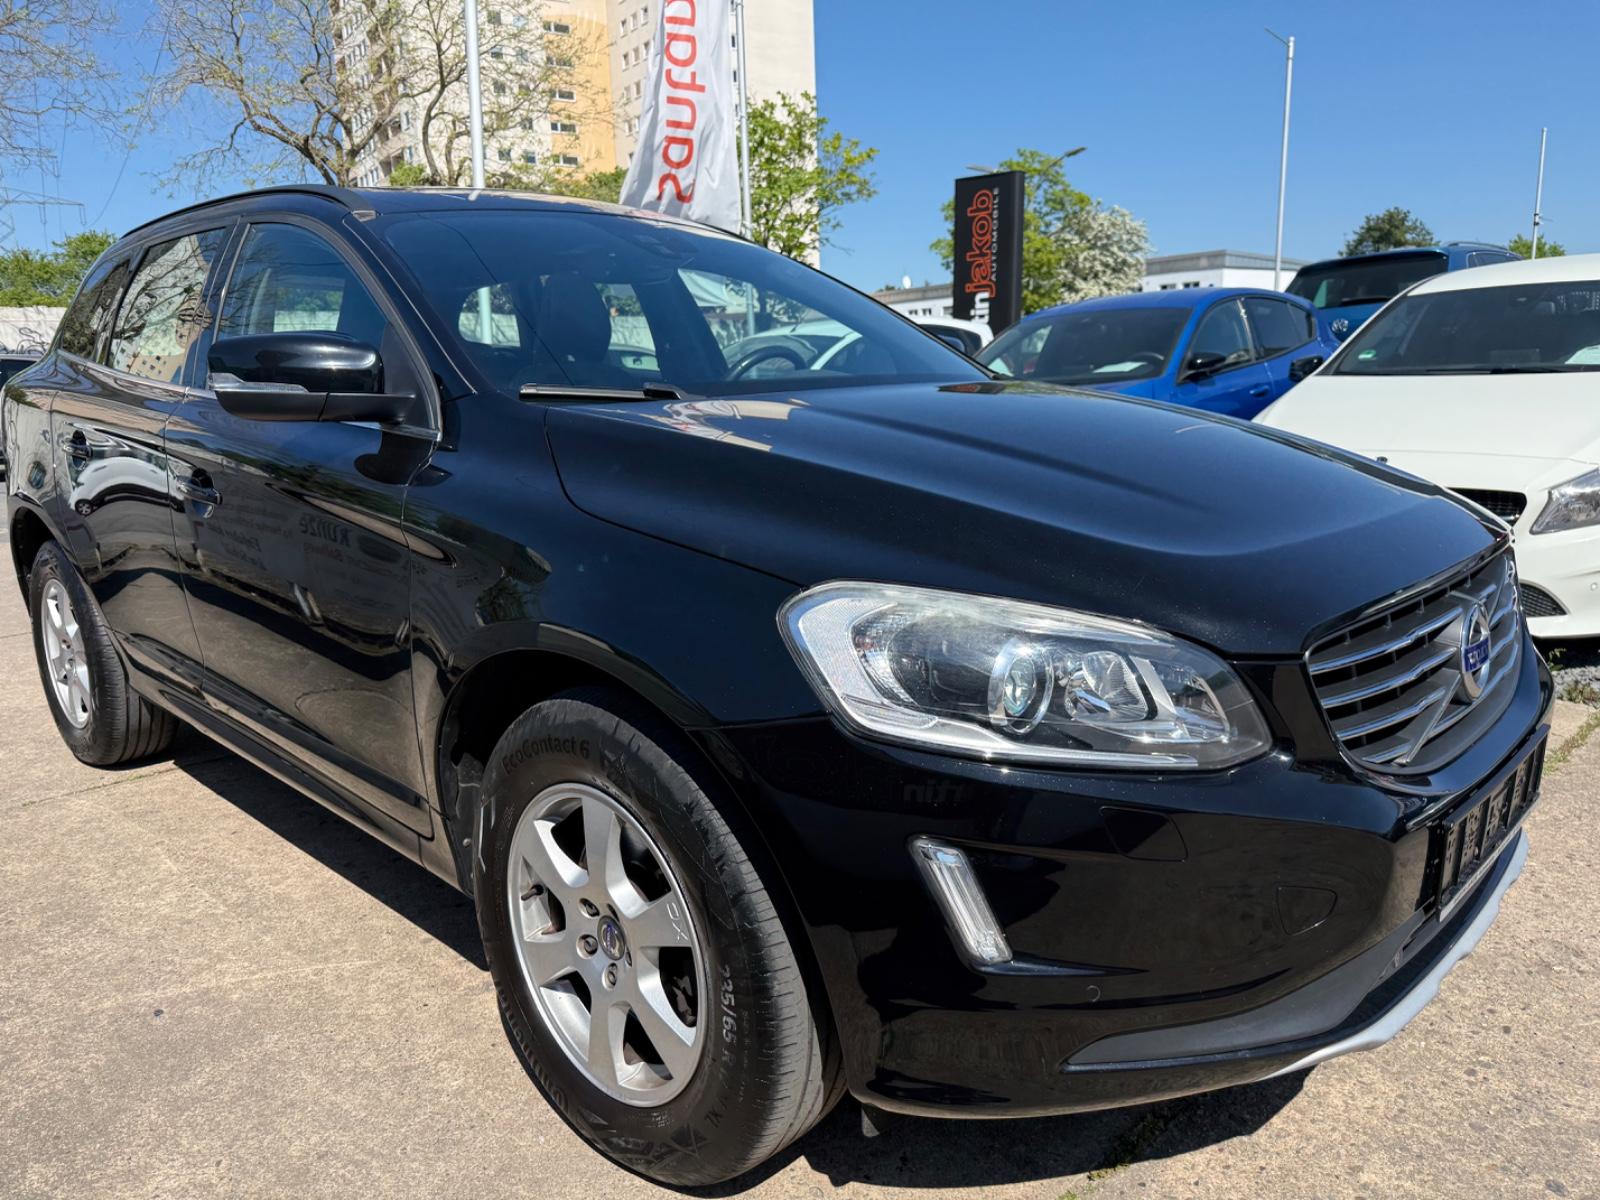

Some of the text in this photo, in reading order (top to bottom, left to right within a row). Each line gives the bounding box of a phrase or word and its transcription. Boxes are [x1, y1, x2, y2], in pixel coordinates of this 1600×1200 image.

[965, 189, 996, 298] jakob
[502, 734, 590, 775] EcoContact 6
